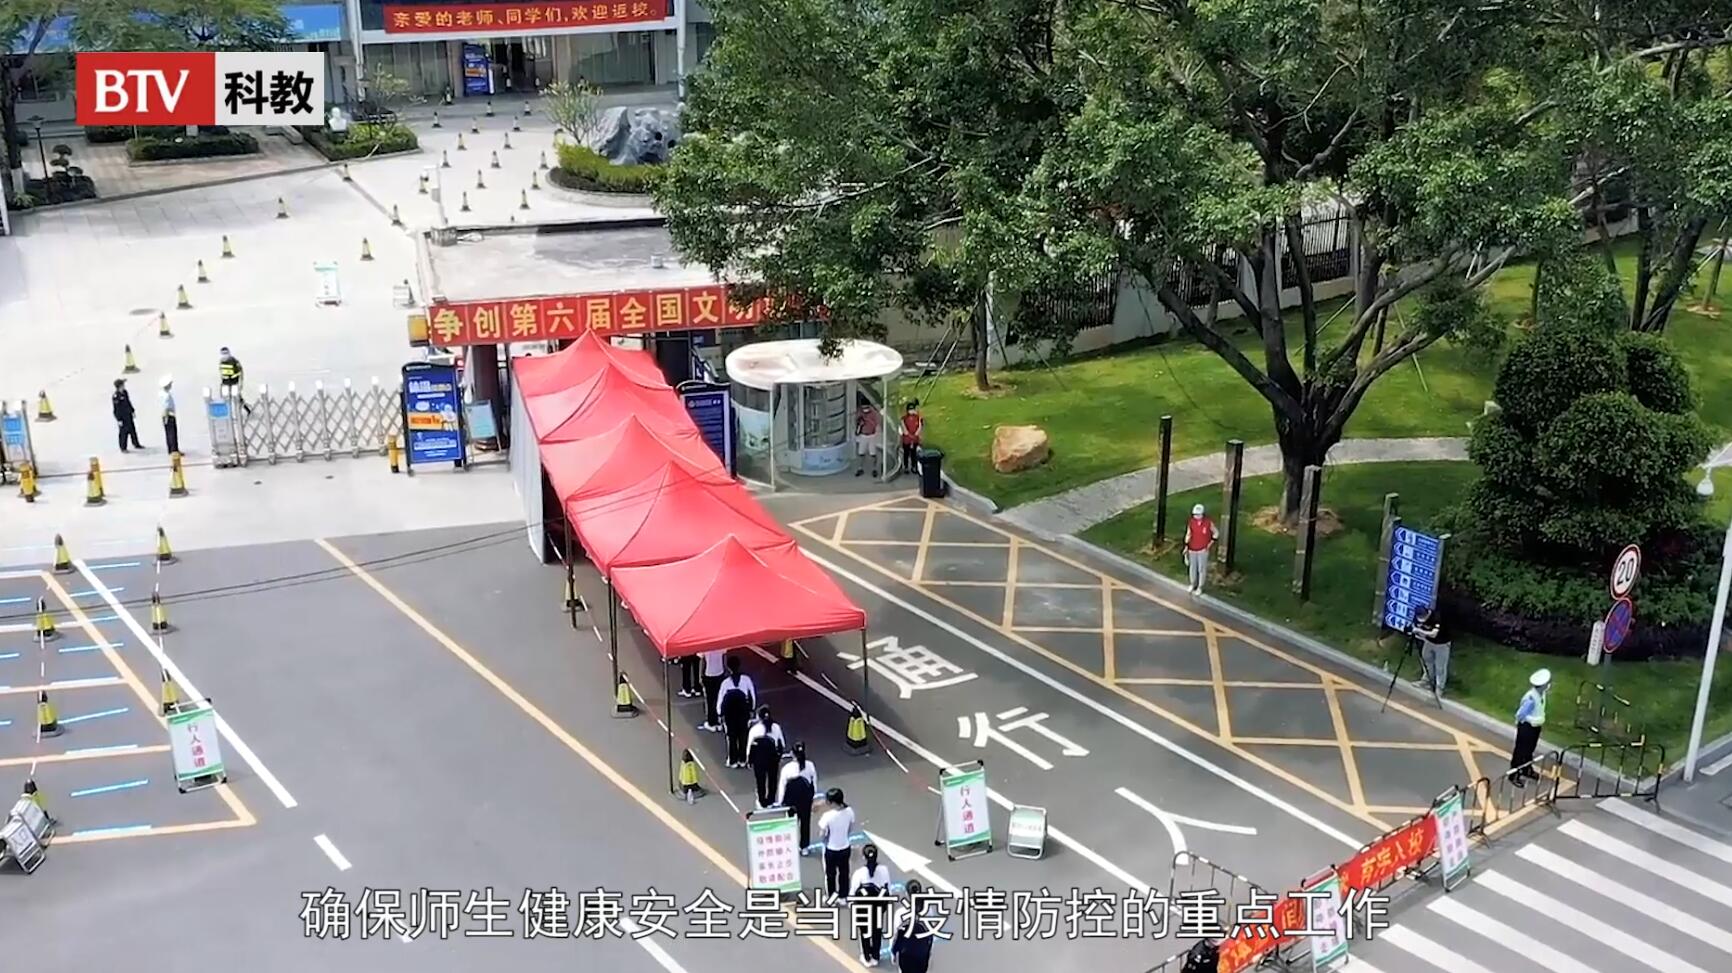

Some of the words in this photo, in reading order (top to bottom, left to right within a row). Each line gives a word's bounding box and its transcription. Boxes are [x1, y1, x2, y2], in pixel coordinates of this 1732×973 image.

[1616, 557, 1634, 586] 20
[959, 783, 976, 835] 行人通道
